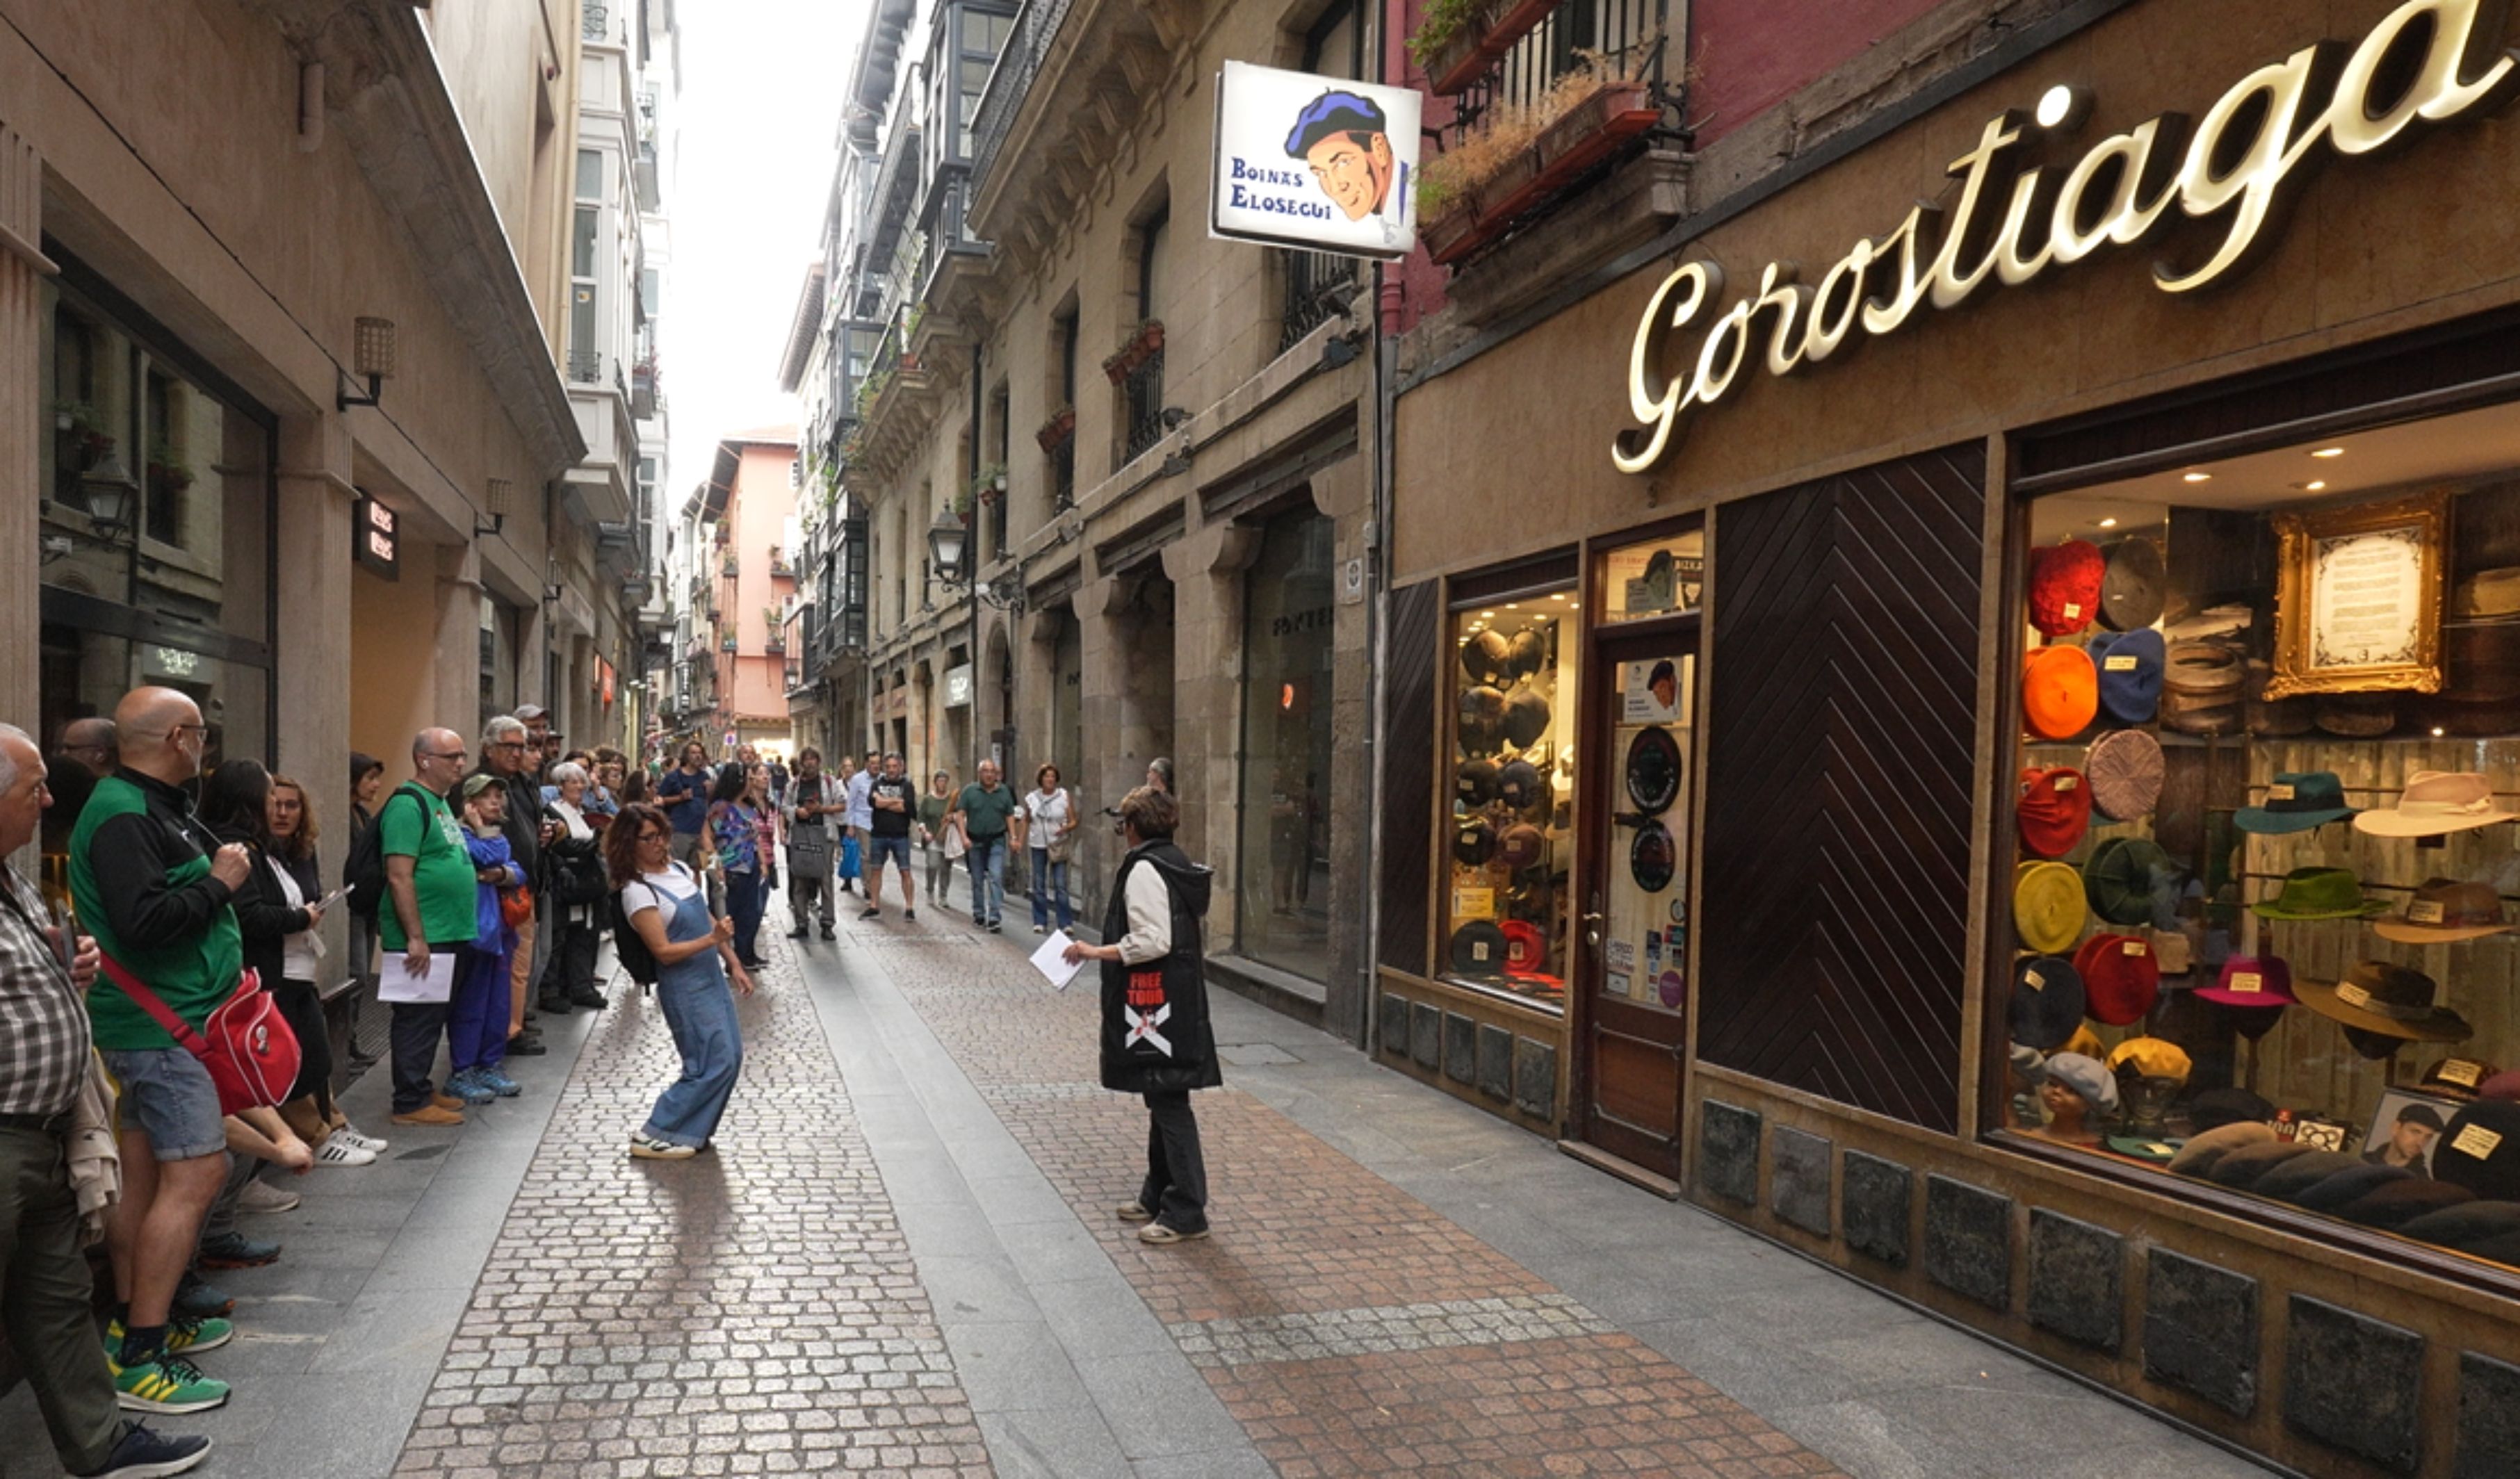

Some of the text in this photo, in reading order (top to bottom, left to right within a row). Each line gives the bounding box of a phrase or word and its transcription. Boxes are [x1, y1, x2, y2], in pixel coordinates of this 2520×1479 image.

[1611, 0, 2515, 474] Gorostiaga
[1131, 972, 1162, 989] FREE
[1127, 989, 1165, 1006] TOUR
